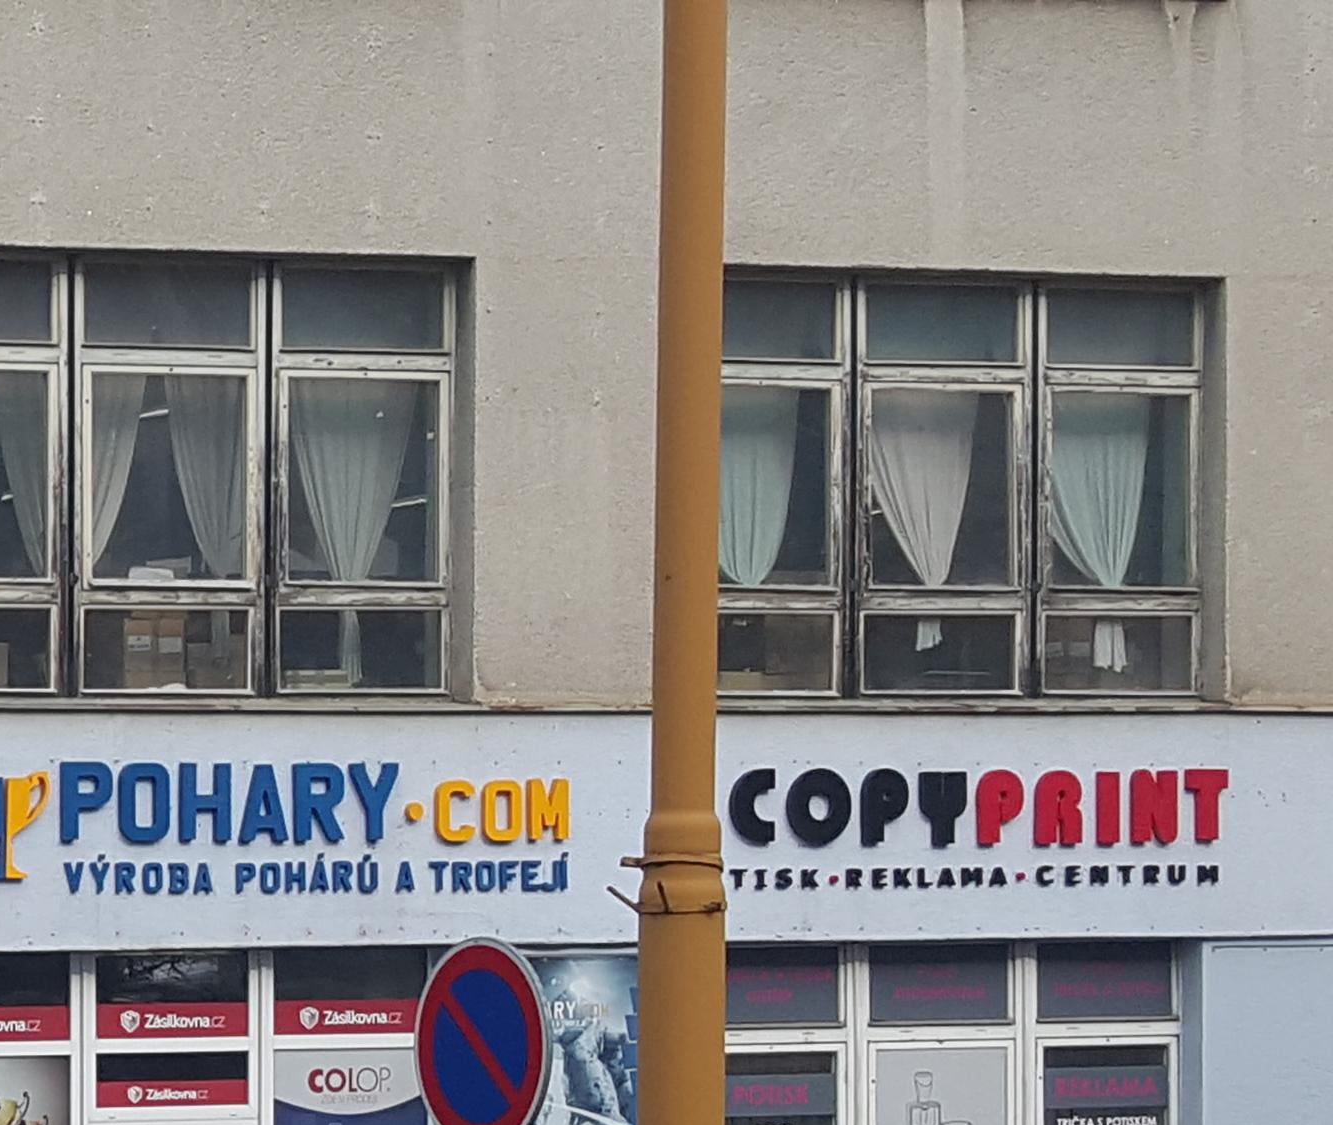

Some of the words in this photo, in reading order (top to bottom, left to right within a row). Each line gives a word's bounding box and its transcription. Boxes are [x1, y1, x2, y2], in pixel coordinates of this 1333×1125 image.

[728, 768, 1229, 849] COPYPRINT
[63, 854, 212, 896] VÝROBA
[235, 852, 380, 895] POHÁRŮ
[395, 861, 415, 894] A
[429, 852, 569, 894] TROFEJÍ
[308, 1067, 391, 1094] COLOP
